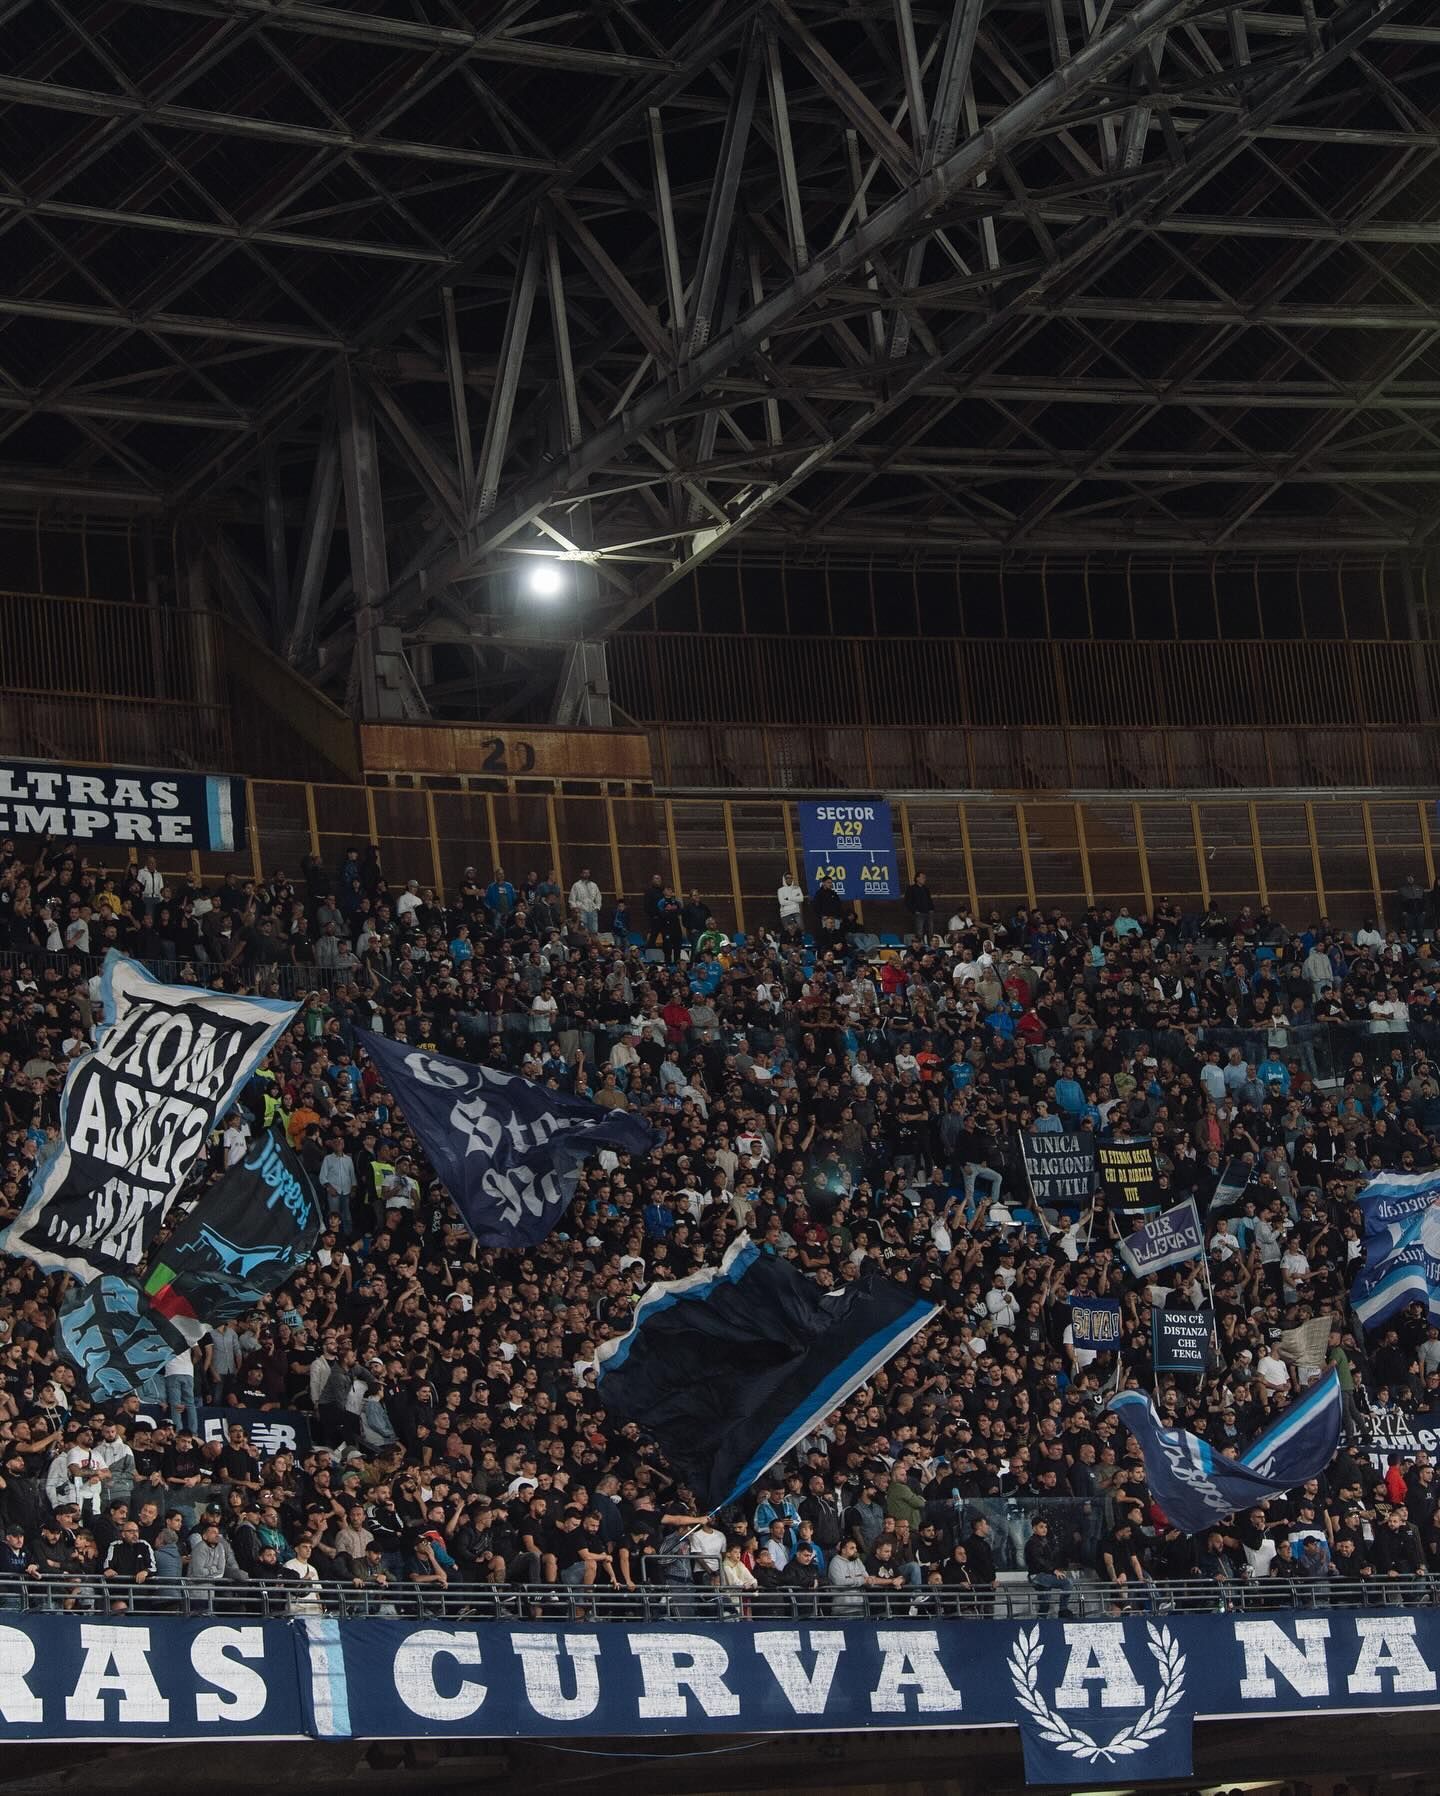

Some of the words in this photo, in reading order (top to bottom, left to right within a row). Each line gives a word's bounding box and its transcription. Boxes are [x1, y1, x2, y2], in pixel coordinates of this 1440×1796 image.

[816, 807, 875, 820] SECTOR
[0, 803, 193, 843] MPRE
[832, 821, 863, 836] A29
[815, 865, 847, 880] A20
[860, 865, 889, 881] A21
[1032, 1135, 1080, 1153] UNICA
[1099, 1149, 1108, 1163] IN
[1108, 1150, 1132, 1164] ETERNO
[1132, 1149, 1152, 1163] RESTA
[1027, 1155, 1094, 1175] RAGIONE
[1105, 1168, 1117, 1182] CHI
[1118, 1168, 1127, 1182] DA
[1128, 1167, 1153, 1182] RIBELLE
[1032, 1180, 1050, 1197] DI
[1056, 1177, 1088, 1196] VITA
[1123, 1187, 1139, 1202] VIVE
[1165, 1314, 1186, 1324] NON
[1163, 1326, 1208, 1336] DISTANZA
[1177, 1338, 1197, 1348] CHE
[1171, 1349, 1202, 1359] TENGA
[393, 1629, 963, 1721] CURVA
[1055, 1621, 1146, 1709] A
[1233, 1616, 1438, 1698] NA
